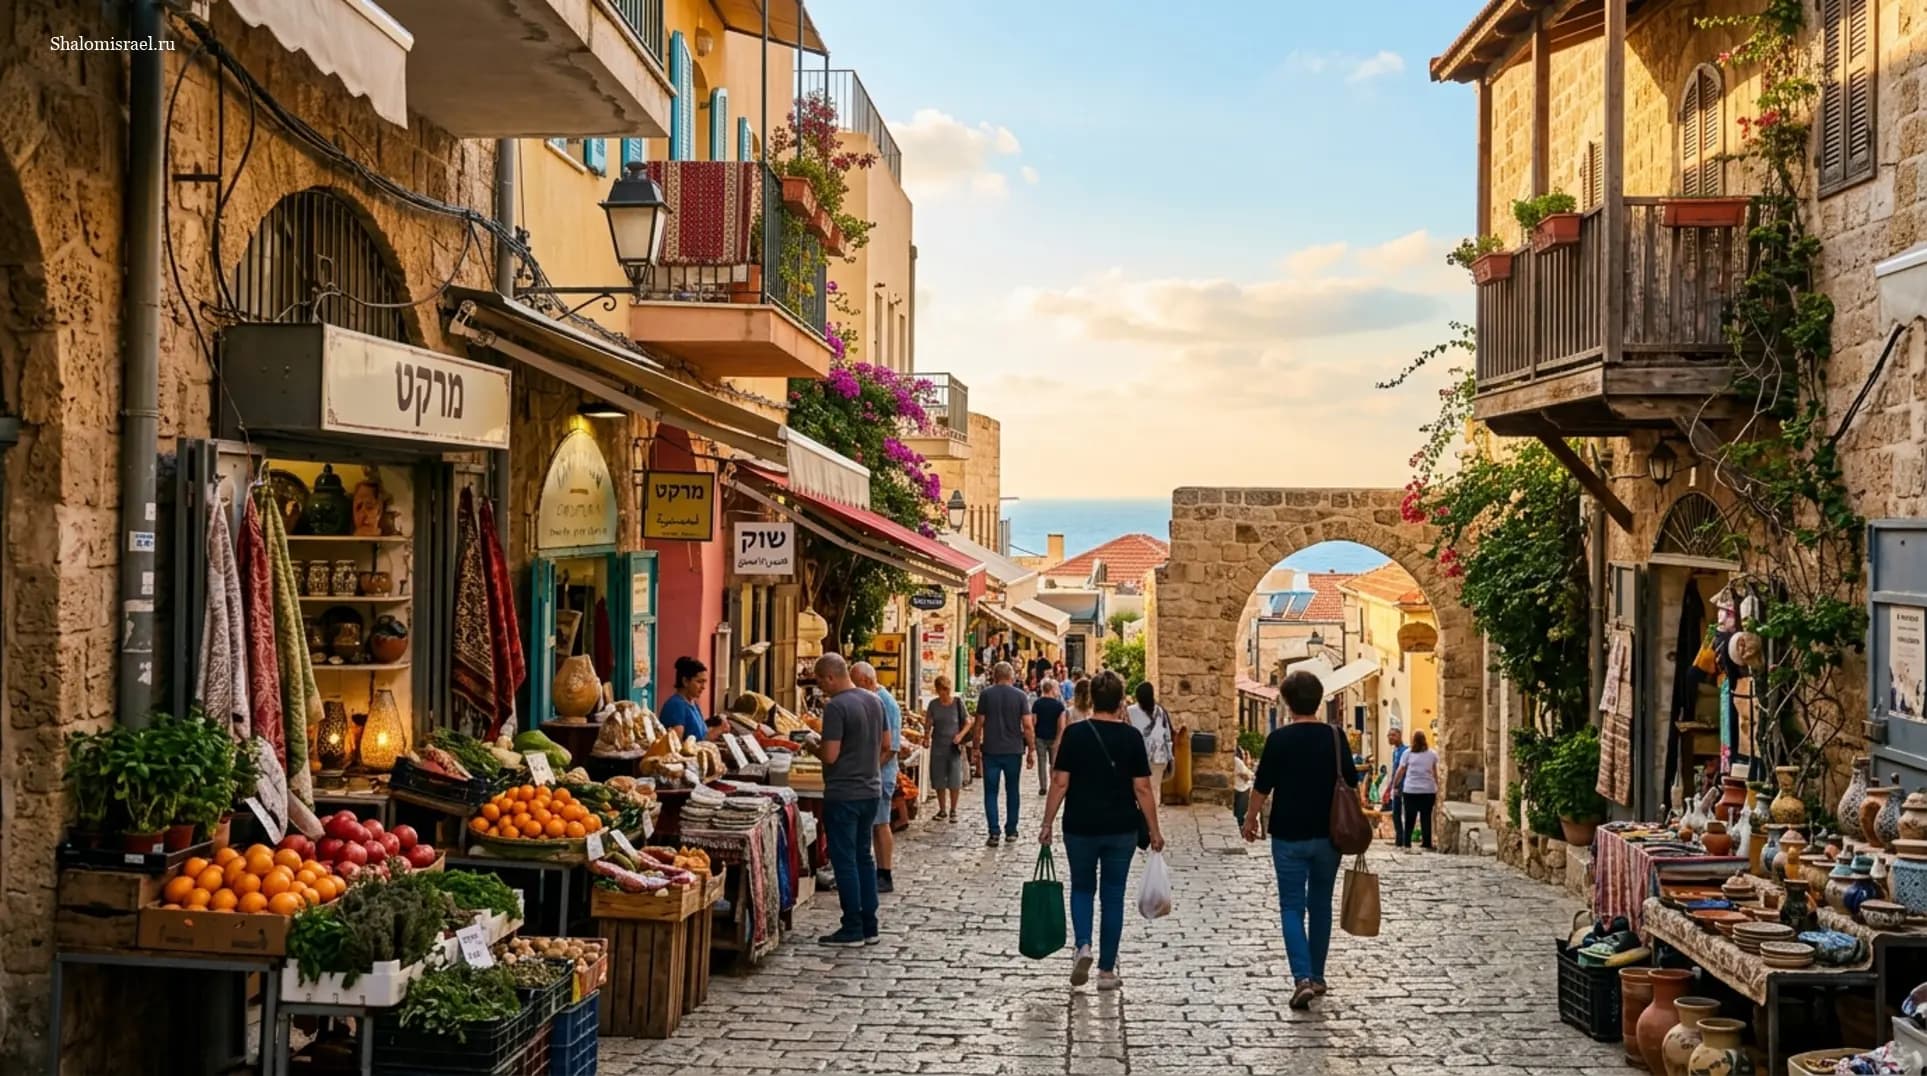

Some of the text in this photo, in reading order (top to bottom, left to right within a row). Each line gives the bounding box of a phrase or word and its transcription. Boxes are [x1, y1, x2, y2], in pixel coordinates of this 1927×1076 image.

[395, 360, 464, 427] מרקט
[655, 483, 704, 503] מרקט
[741, 530, 786, 553] שוק
